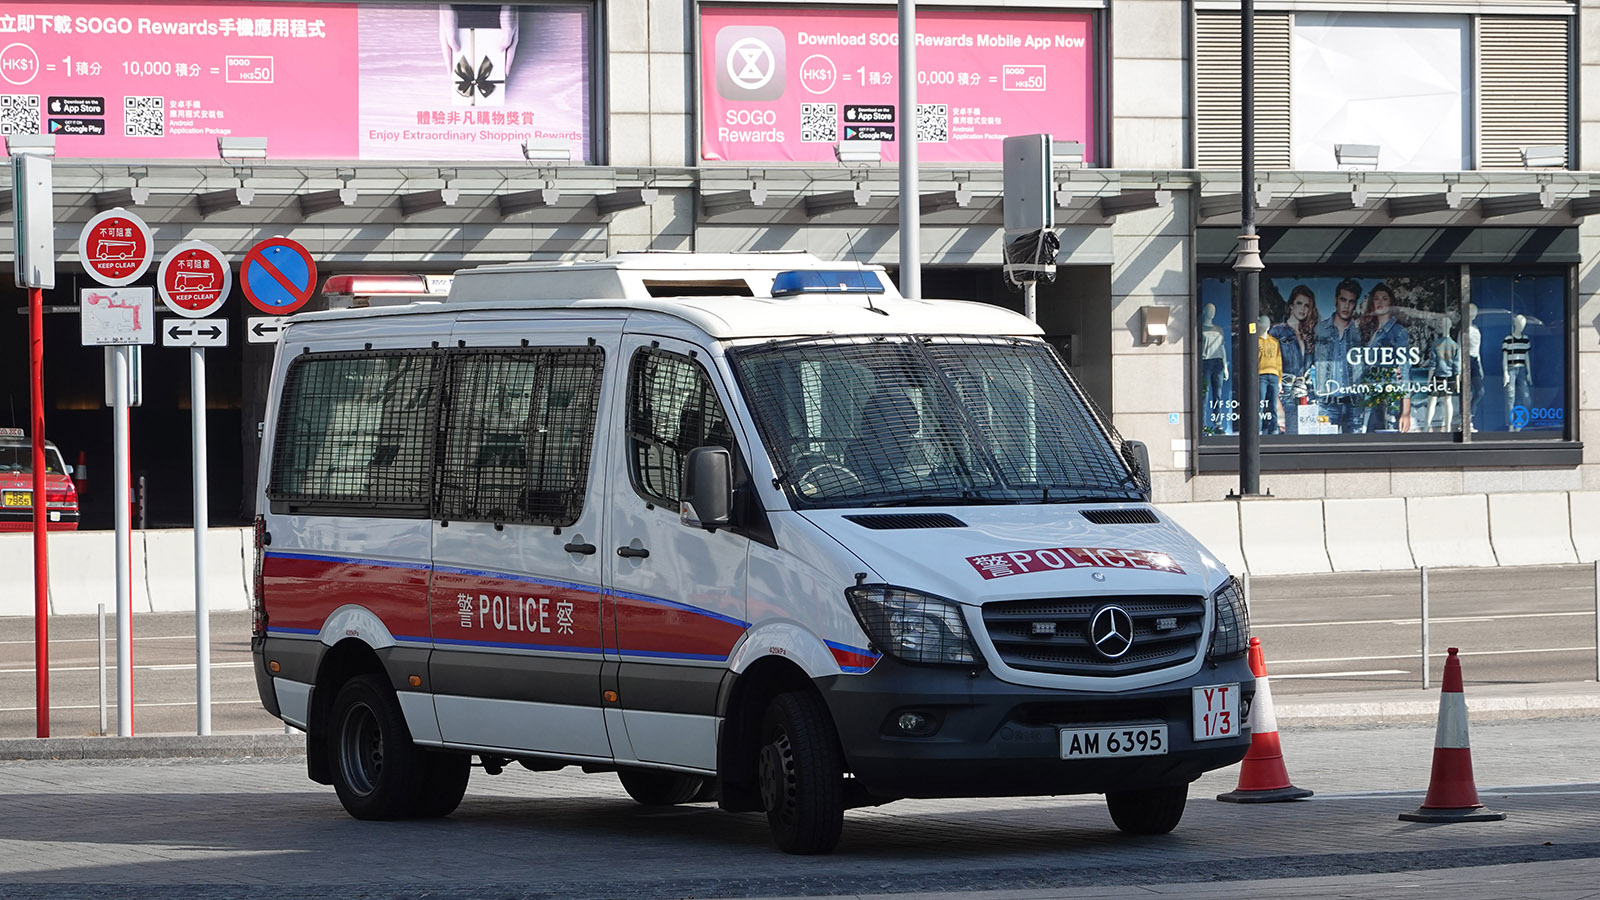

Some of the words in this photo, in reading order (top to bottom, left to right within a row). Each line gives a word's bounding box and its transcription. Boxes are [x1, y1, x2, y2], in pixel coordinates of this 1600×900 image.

[0, 14, 72, 34] 立即下載
[75, 17, 132, 34] SOGO
[798, 32, 866, 45] Download
[869, 33, 899, 46] SOG
[915, 33, 973, 47] Rewards
[977, 34, 1021, 47] Mobile
[1024, 35, 1051, 50] App
[1055, 35, 1085, 47] Now
[2, 58, 34, 71] HK$1
[122, 61, 171, 77] 10,000
[175, 63, 201, 77] 積分
[803, 68, 832, 80] HK$1
[917, 71, 954, 86] 0,000
[957, 72, 981, 86] 積分
[63, 105, 80, 113] App
[80, 105, 101, 113] Store
[416, 111, 535, 125] 體驗非凡購物獎賞
[726, 110, 776, 125] SOGO
[857, 113, 873, 121] App
[64, 125, 88, 134] Google
[88, 125, 102, 134] Play
[369, 130, 400, 142] Enjoy
[403, 130, 477, 142] Extraordinary
[479, 131, 531, 142] Shopping
[535, 131, 582, 141] Rewards
[718, 127, 785, 143] Rewards
[858, 132, 879, 140] Google
[880, 132, 893, 141] Play
[99, 228, 132, 238] 不可阻塞
[177, 259, 211, 269] 不可阻塞
[1346, 347, 1421, 365] GUESS
[1316, 380, 1370, 396] Denim
[1209, 400, 1224, 409] 1/F
[1210, 413, 1225, 422] 3/F
[1007, 548, 1152, 573] POLICE
[457, 592, 473, 628] 警
[479, 594, 551, 634] POLICE
[556, 599, 574, 635] 察
[1203, 687, 1229, 711] YT
[1203, 711, 1230, 737] 1/3
[1069, 733, 1099, 755] AM
[1106, 730, 1162, 753] 6395
